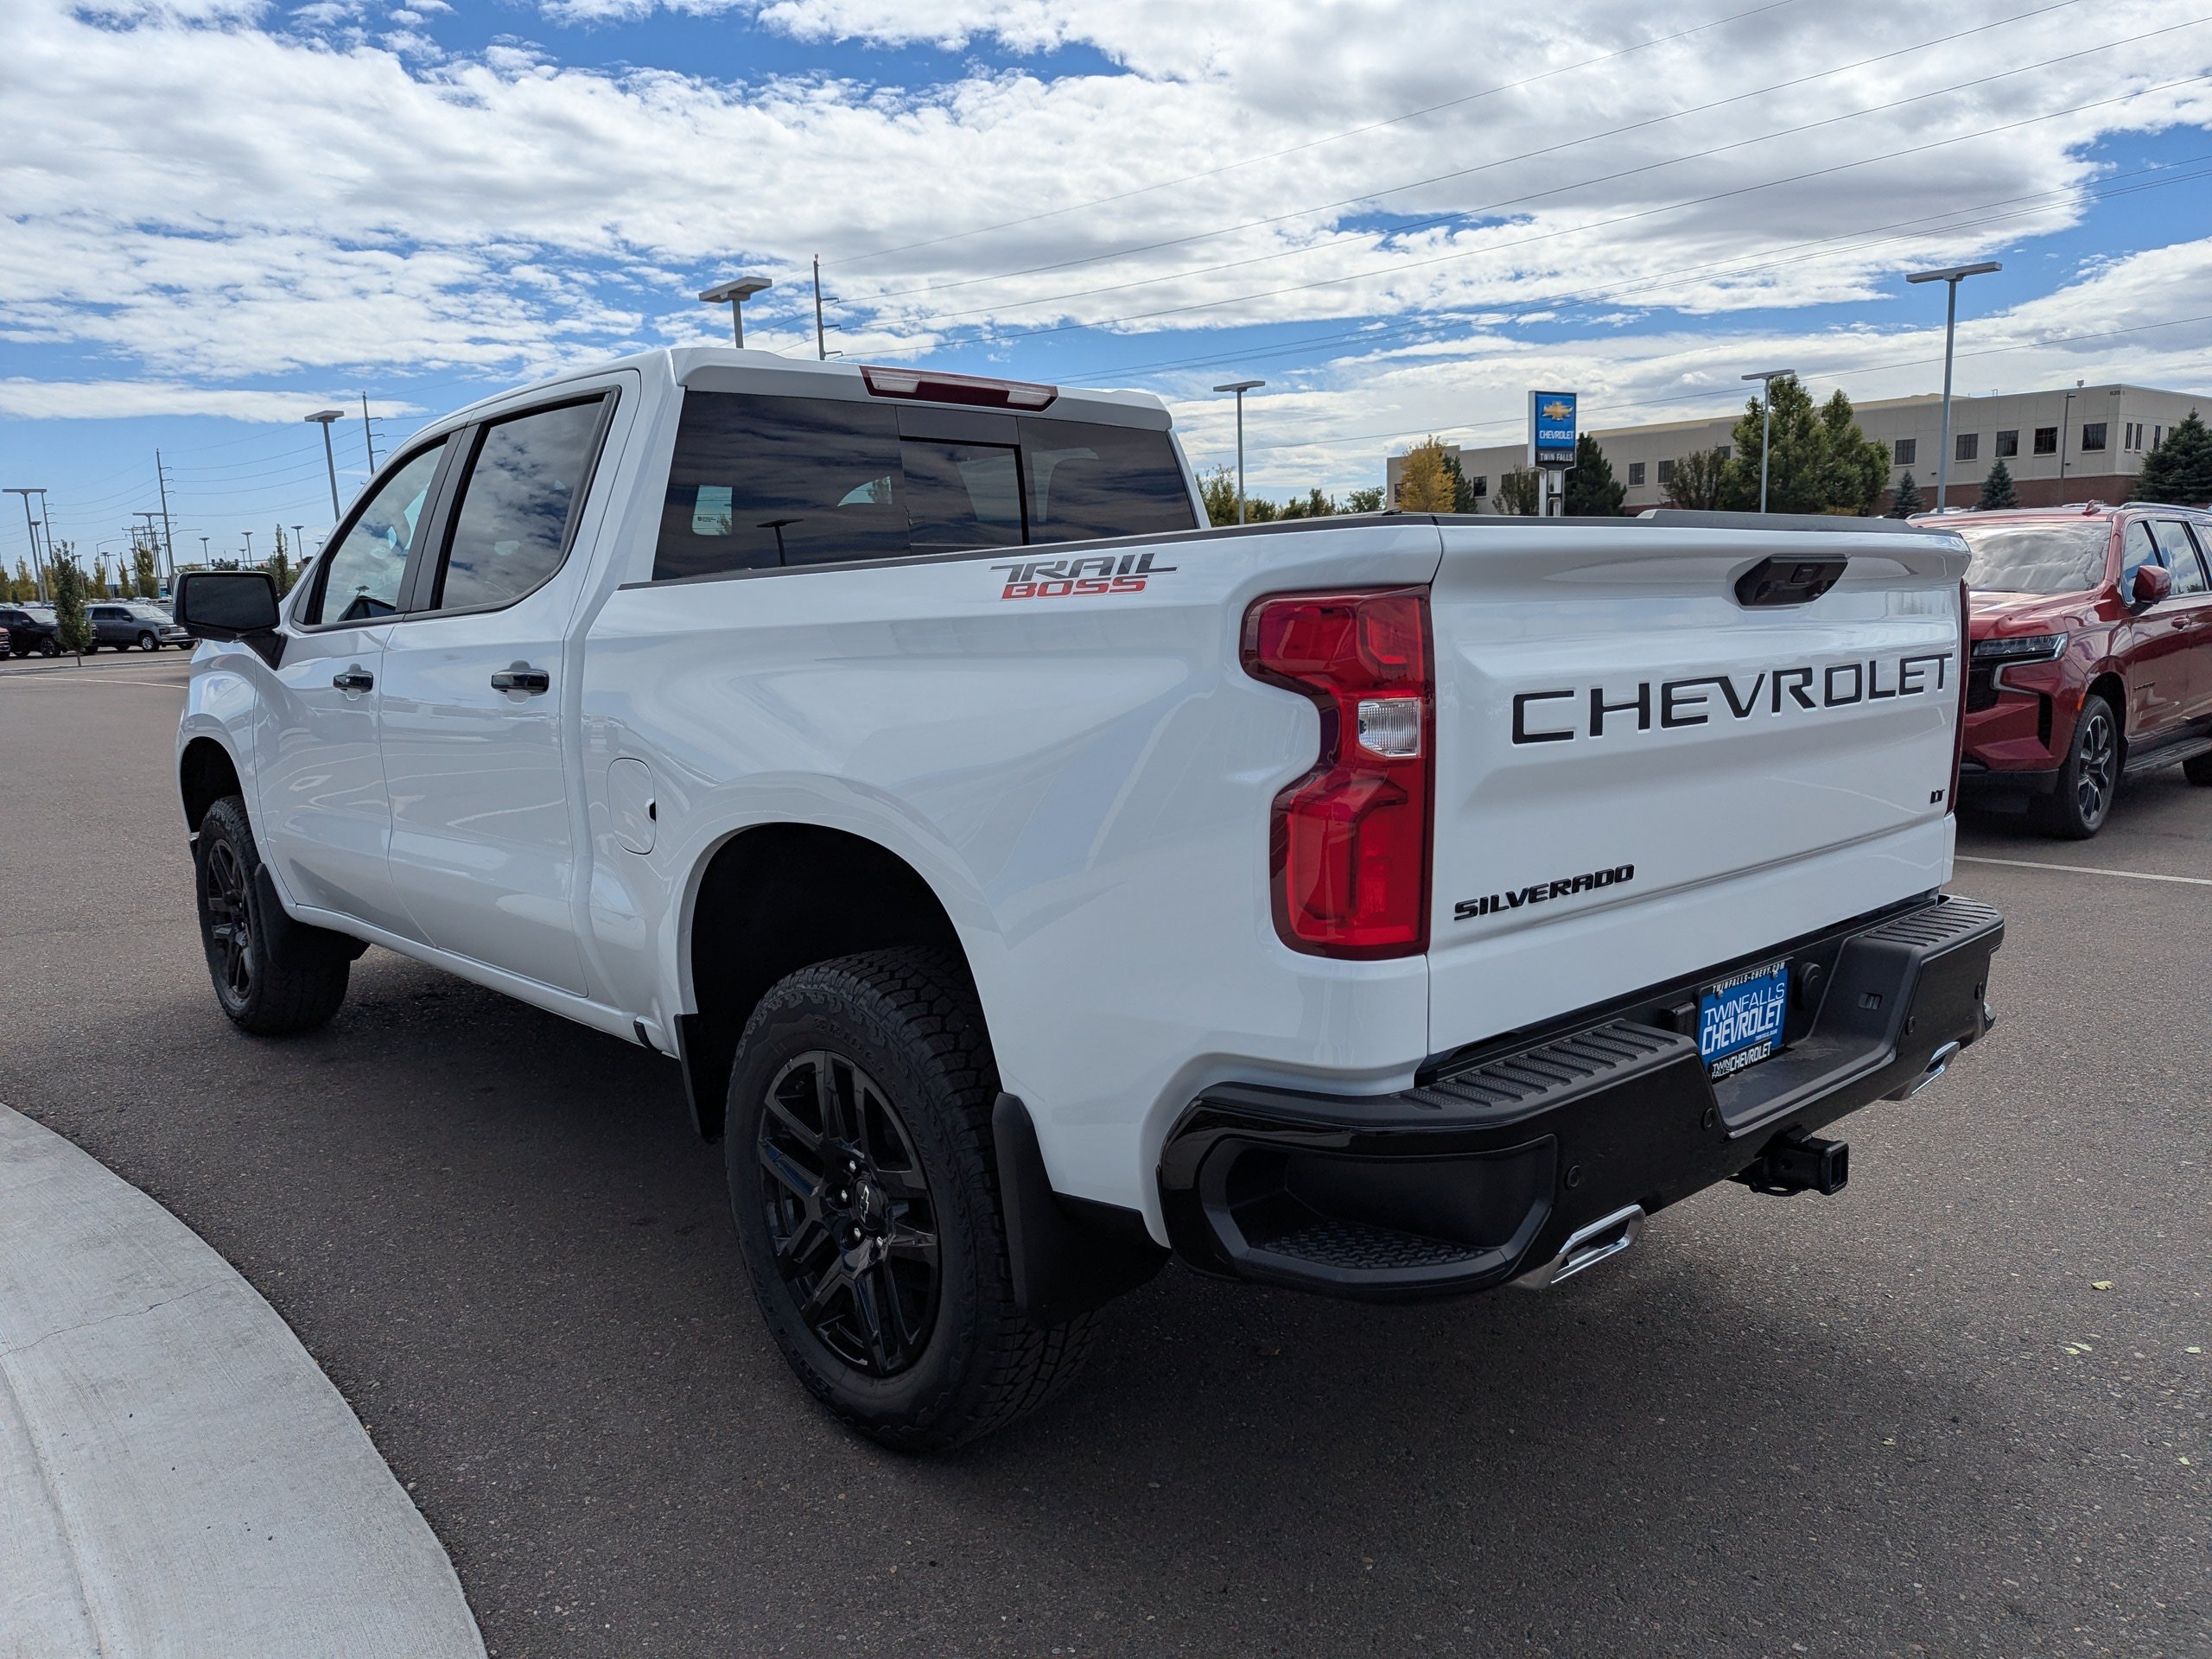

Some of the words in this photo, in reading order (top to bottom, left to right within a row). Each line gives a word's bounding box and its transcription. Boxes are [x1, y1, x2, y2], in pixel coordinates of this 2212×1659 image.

[1539, 430, 1573, 440] CHEVROLET
[1540, 453, 1555, 461] TWIN
[1556, 453, 1573, 462] FALLS
[990, 552, 1178, 583] TRAIL
[1001, 575, 1149, 600] BOSS
[1512, 652, 1954, 746] CHEVROLET
[1453, 863, 1635, 921] SILVERADO
[1701, 998, 1784, 1056] CHEVROLET
[1712, 1058, 1731, 1074] TWIN
[1730, 1040, 1773, 1072] CHEVROLET
[1711, 1065, 1730, 1080] FALLS
